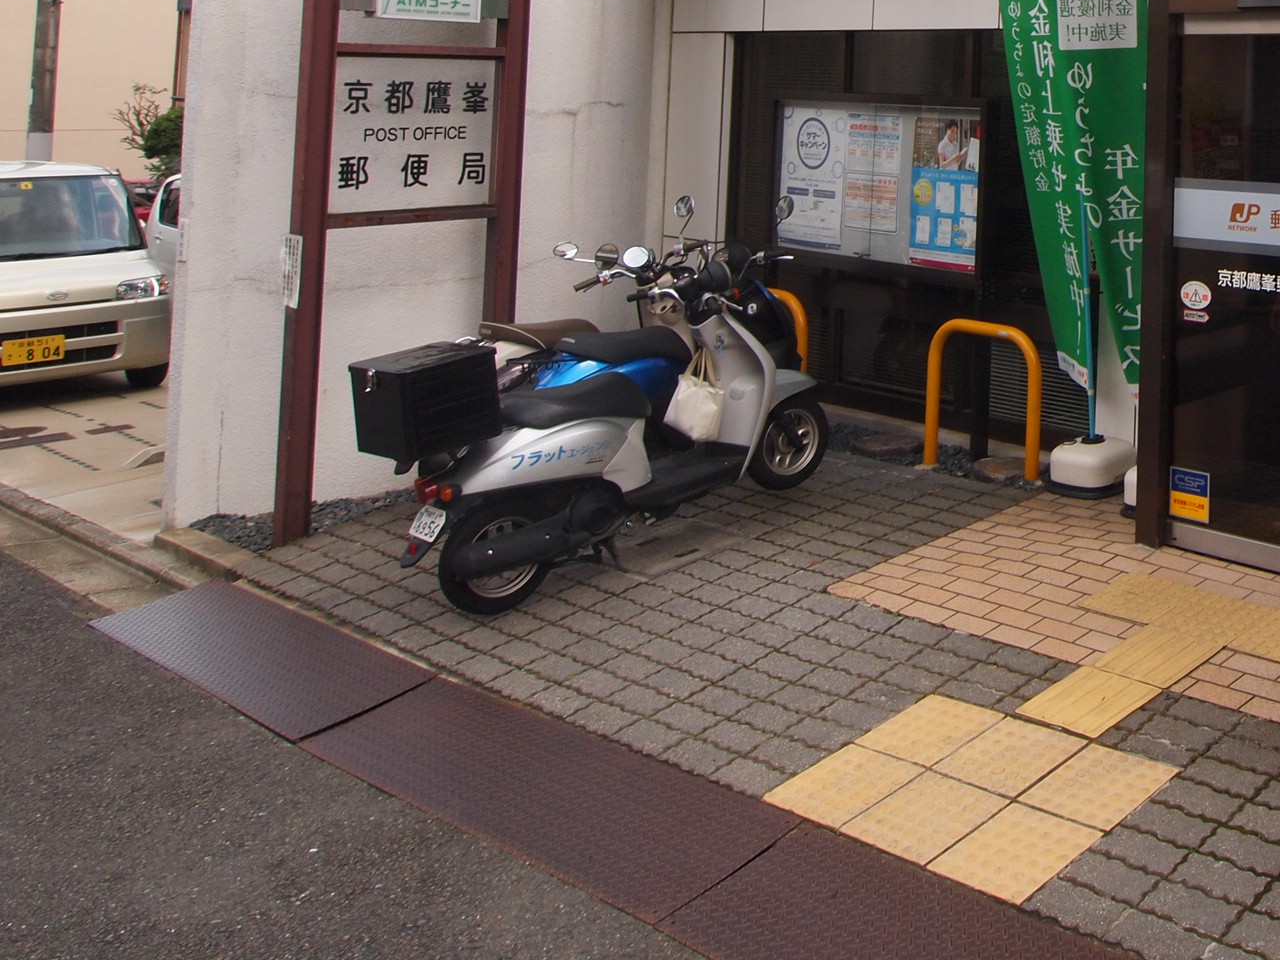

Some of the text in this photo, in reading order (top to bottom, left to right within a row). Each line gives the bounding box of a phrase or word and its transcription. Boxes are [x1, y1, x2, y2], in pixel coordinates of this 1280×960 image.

[343, 79, 489, 114] 京都鷹峯
[364, 126, 467, 142] POST OFFICE
[337, 152, 486, 190] 郵便局
[1229, 202, 1261, 224] JP
[1227, 224, 1258, 233] NETWORK
[1175, 474, 1205, 488] CSP
[415, 521, 440, 539] 6956
